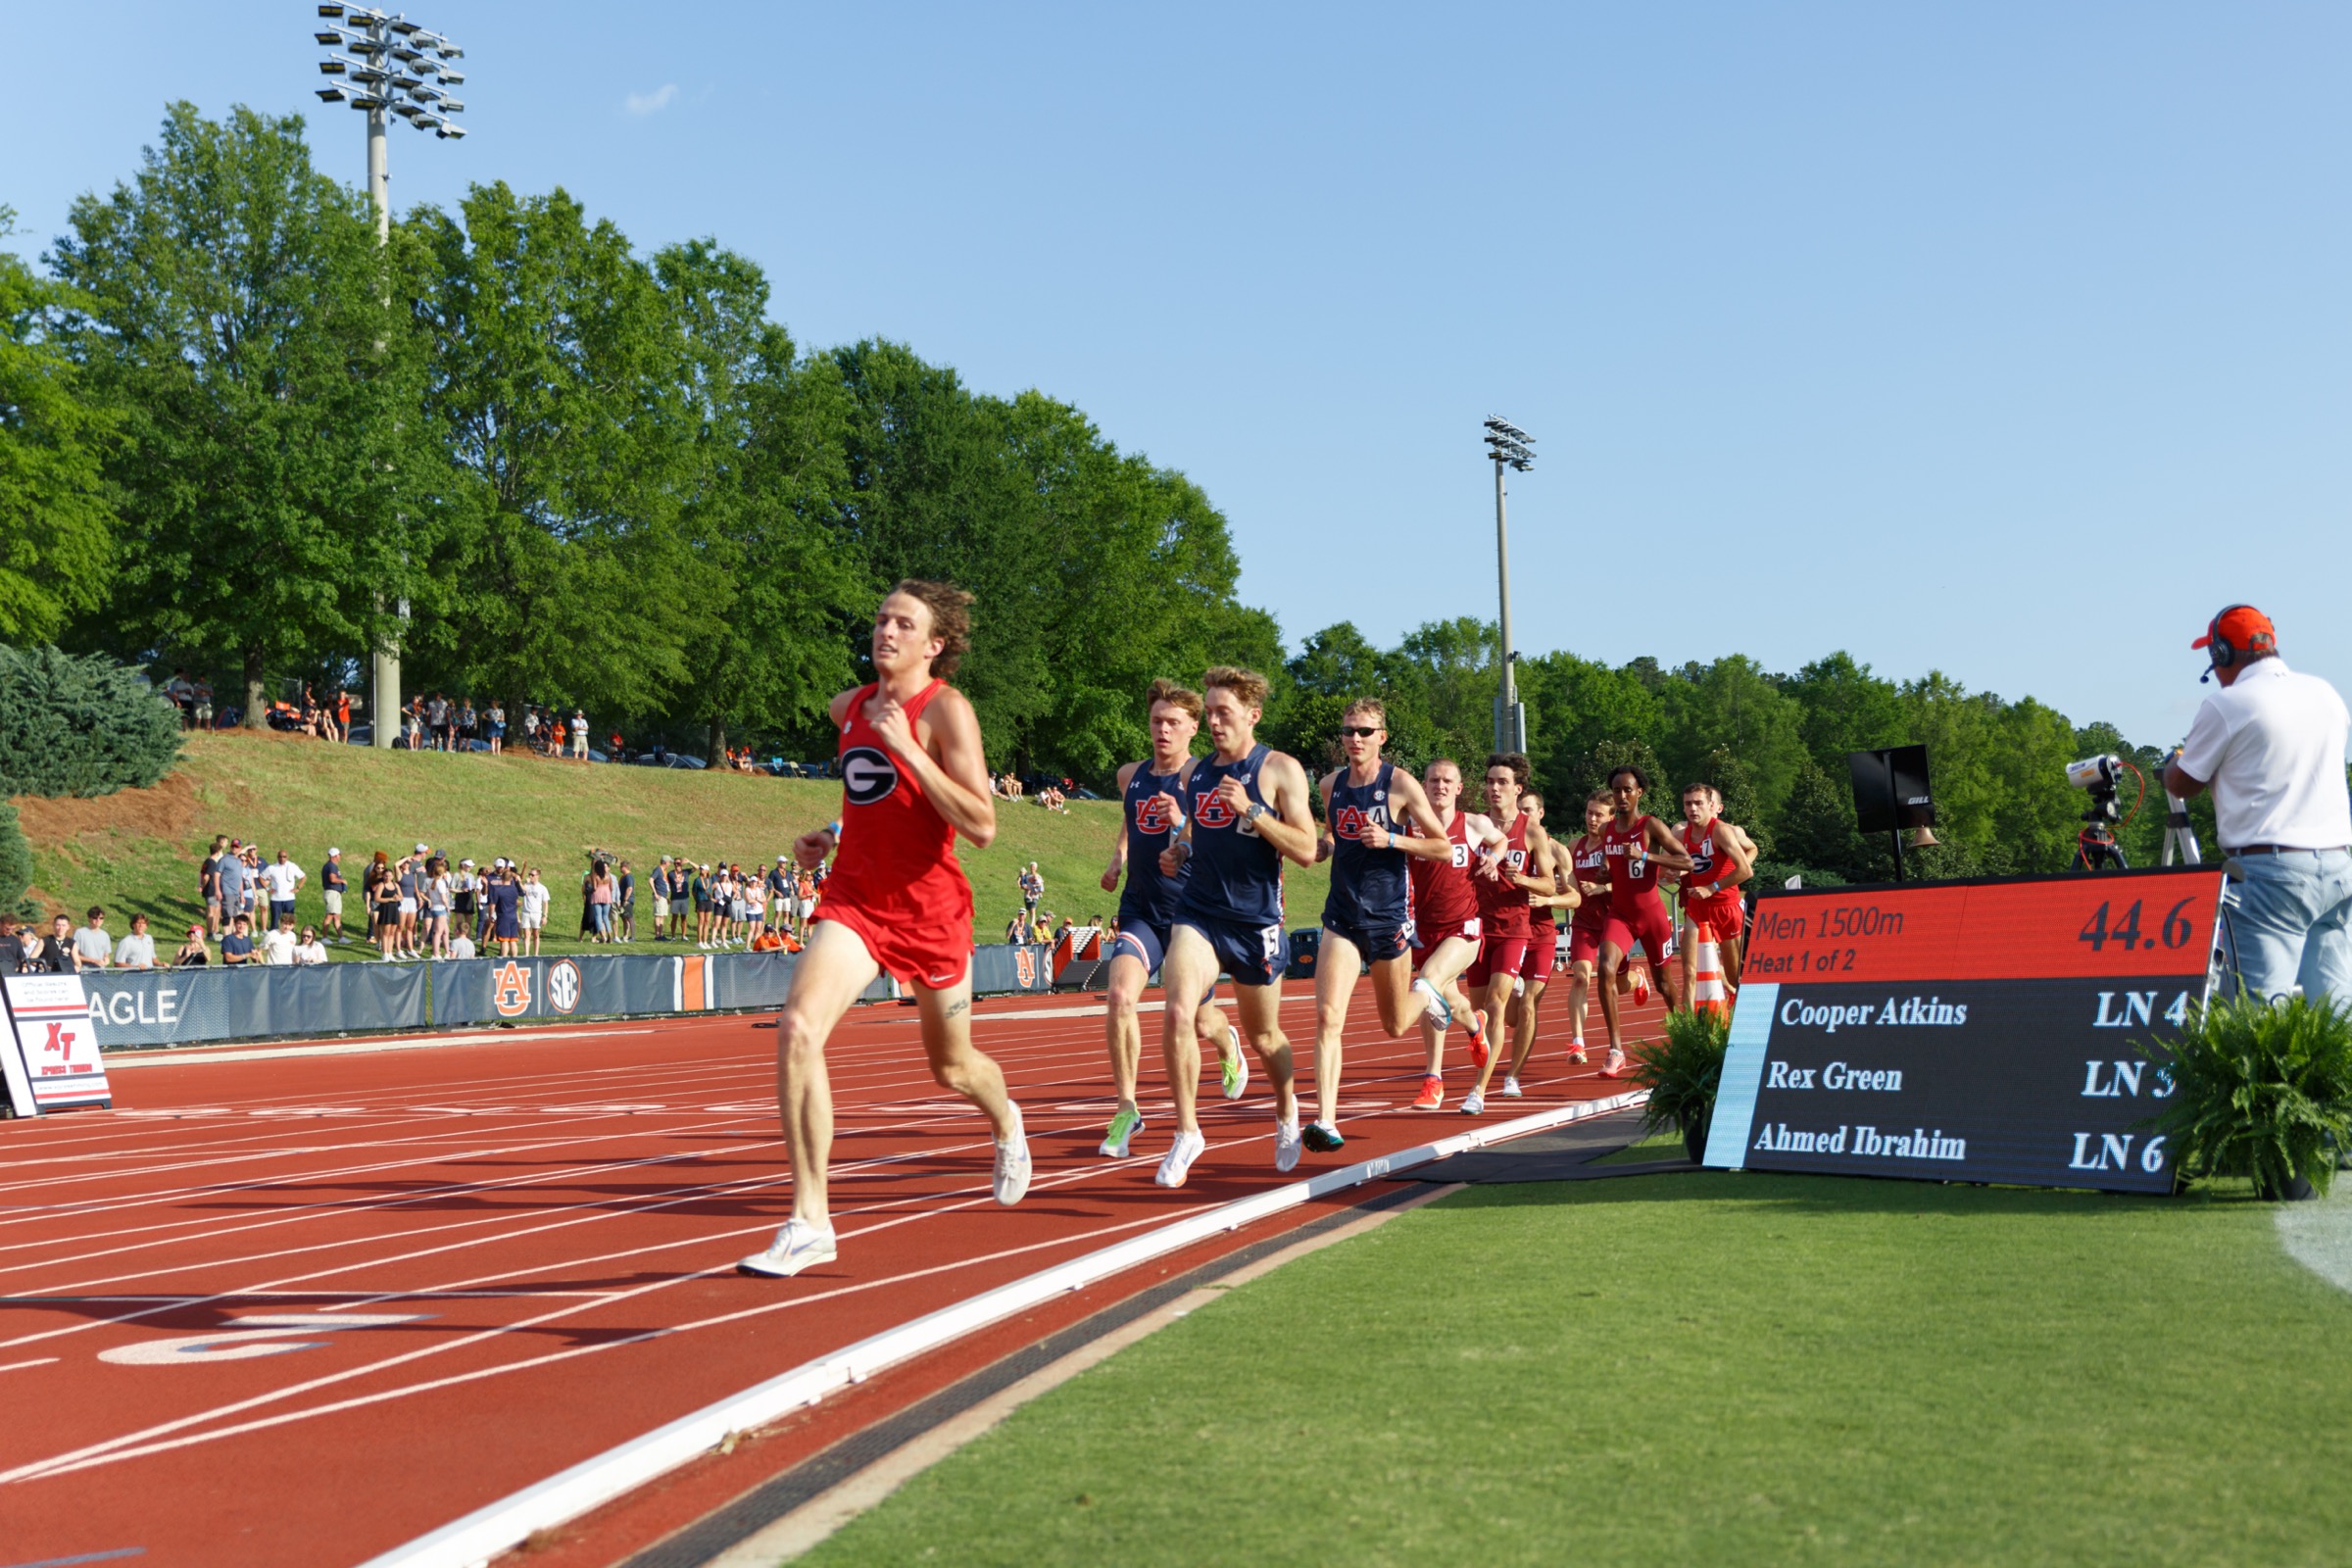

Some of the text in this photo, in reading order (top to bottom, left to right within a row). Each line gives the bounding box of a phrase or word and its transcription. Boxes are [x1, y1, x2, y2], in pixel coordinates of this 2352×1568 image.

[842, 746, 898, 806] G
[1908, 796, 1929, 805] GILL
[1372, 808, 1385, 827] 4
[1455, 845, 1465, 865] 3
[1513, 851, 1522, 866] 9
[1592, 854, 1602, 866] 10
[1703, 839, 1710, 856] 7
[1632, 860, 1642, 877] 6
[1755, 906, 1904, 940] Men 1500m
[2079, 896, 2196, 952] 44.6
[1748, 949, 1856, 973] Heat 1 of 2
[88, 990, 177, 1025] AGLE
[1781, 990, 2188, 1033] Cooper Atkins LN 4
[44, 1022, 75, 1060] XT
[1766, 1060, 1817, 1089] Rex
[1823, 1061, 1903, 1091] Green
[2081, 1059, 2147, 1097] LN
[1754, 1123, 2167, 1173] Ahmed Ibrahim LN 6
